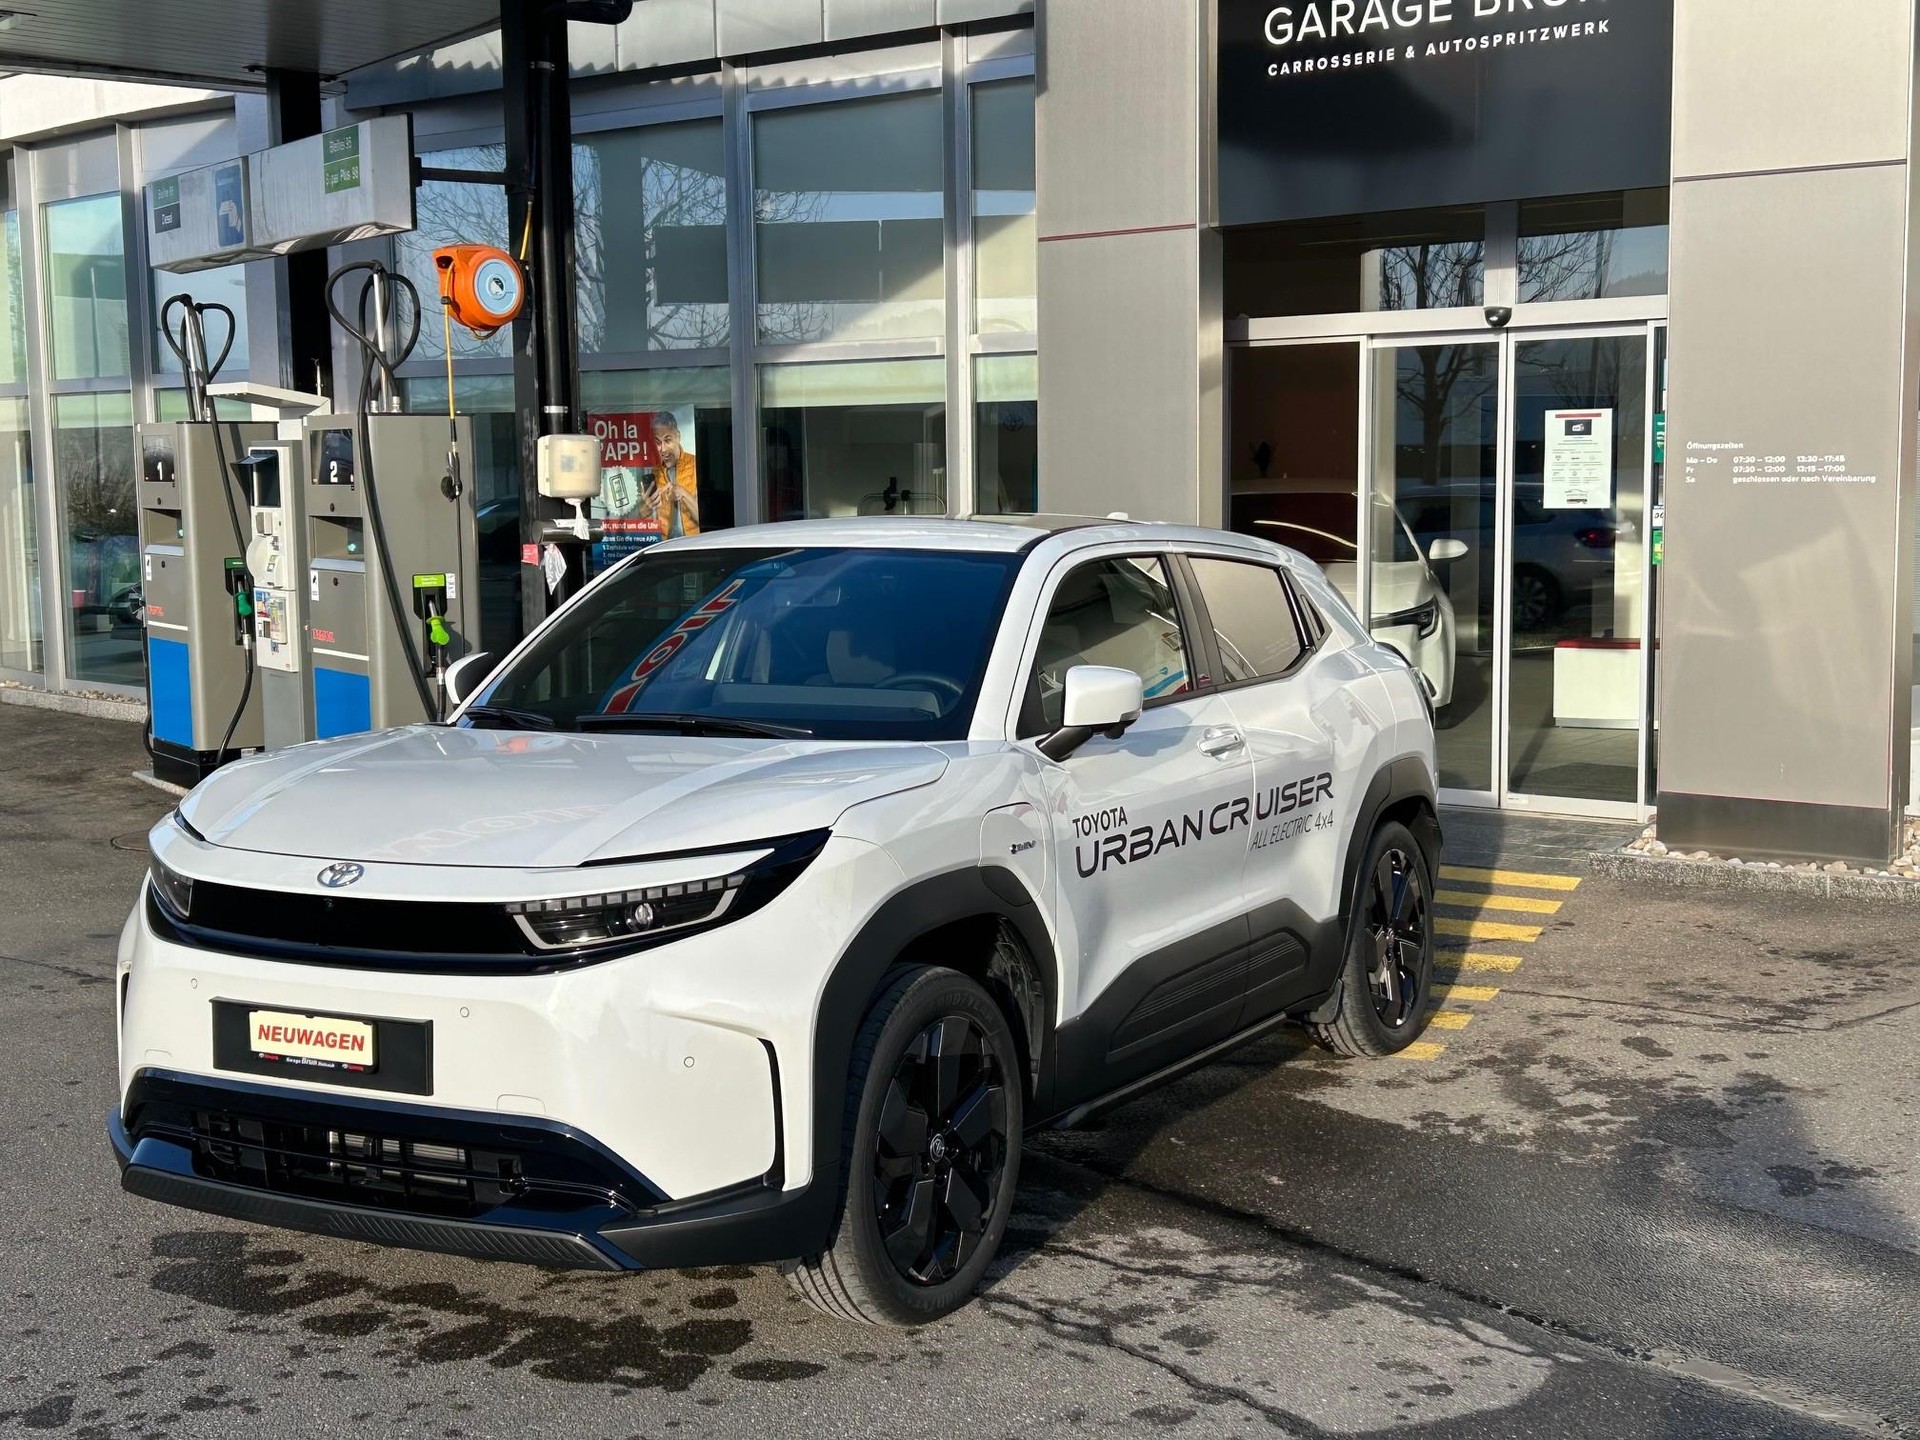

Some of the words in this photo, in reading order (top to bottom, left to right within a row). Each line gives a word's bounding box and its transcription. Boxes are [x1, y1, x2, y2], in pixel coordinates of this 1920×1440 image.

[1263, 0, 1453, 46] GARAGE
[1267, 48, 1396, 77] CARROSSERIE
[1404, 45, 1415, 59] &
[1425, 19, 1611, 57] AUTOSPRITZWERK
[594, 420, 618, 440] Oh
[623, 419, 638, 439] la
[156, 461, 163, 481] 1
[329, 460, 338, 483] 2
[1685, 466, 1694, 474] Fr
[1764, 465, 1786, 473] 12:00
[1823, 464, 1846, 473] 17:00
[1764, 455, 1786, 463] 12:00
[1732, 475, 1780, 485] geschlossen
[1781, 475, 1800, 483] oder
[1800, 474, 1820, 483] nach
[1822, 474, 1876, 485] Vereinbarung
[1072, 806, 1128, 839] TOYOTA
[1075, 809, 1204, 879] URBAN
[1209, 771, 1335, 835] CRUISER
[1250, 828, 1268, 851] ALL
[1269, 812, 1312, 846] ELECTRIC
[1313, 809, 1335, 831] 4x4
[257, 1024, 365, 1052] NEUWAGEN
